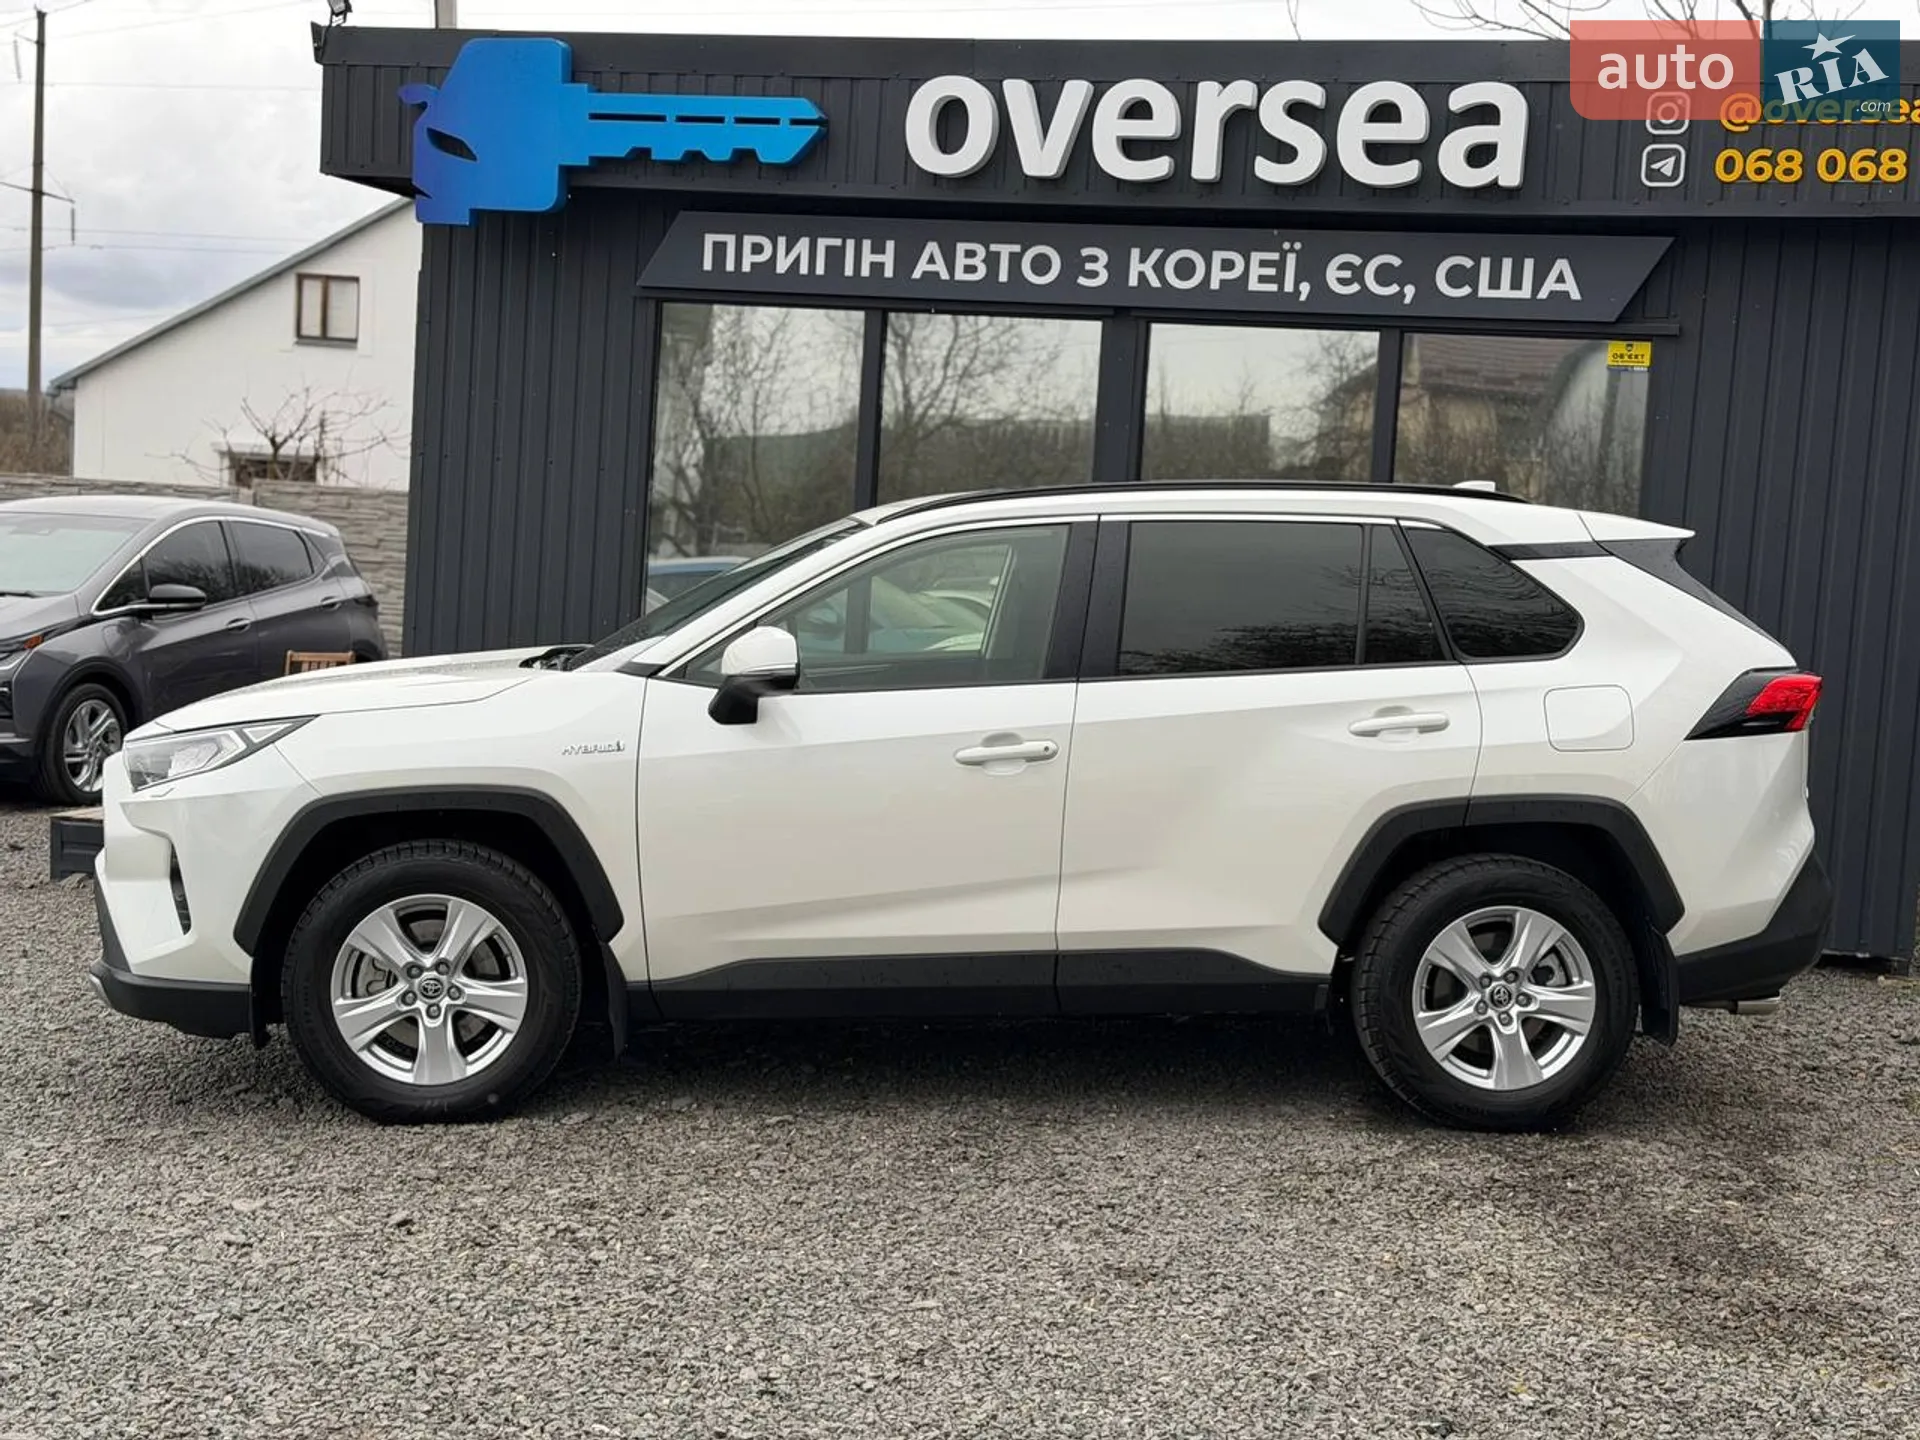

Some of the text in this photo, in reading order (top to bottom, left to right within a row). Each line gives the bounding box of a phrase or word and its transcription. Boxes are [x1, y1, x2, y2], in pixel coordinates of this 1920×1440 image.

[905, 74, 1529, 186] oversea
[1714, 147, 1908, 183] 068 068
[703, 233, 1582, 305] ПРИГІН АВТО З КОРЕЇ, ЄС, США
